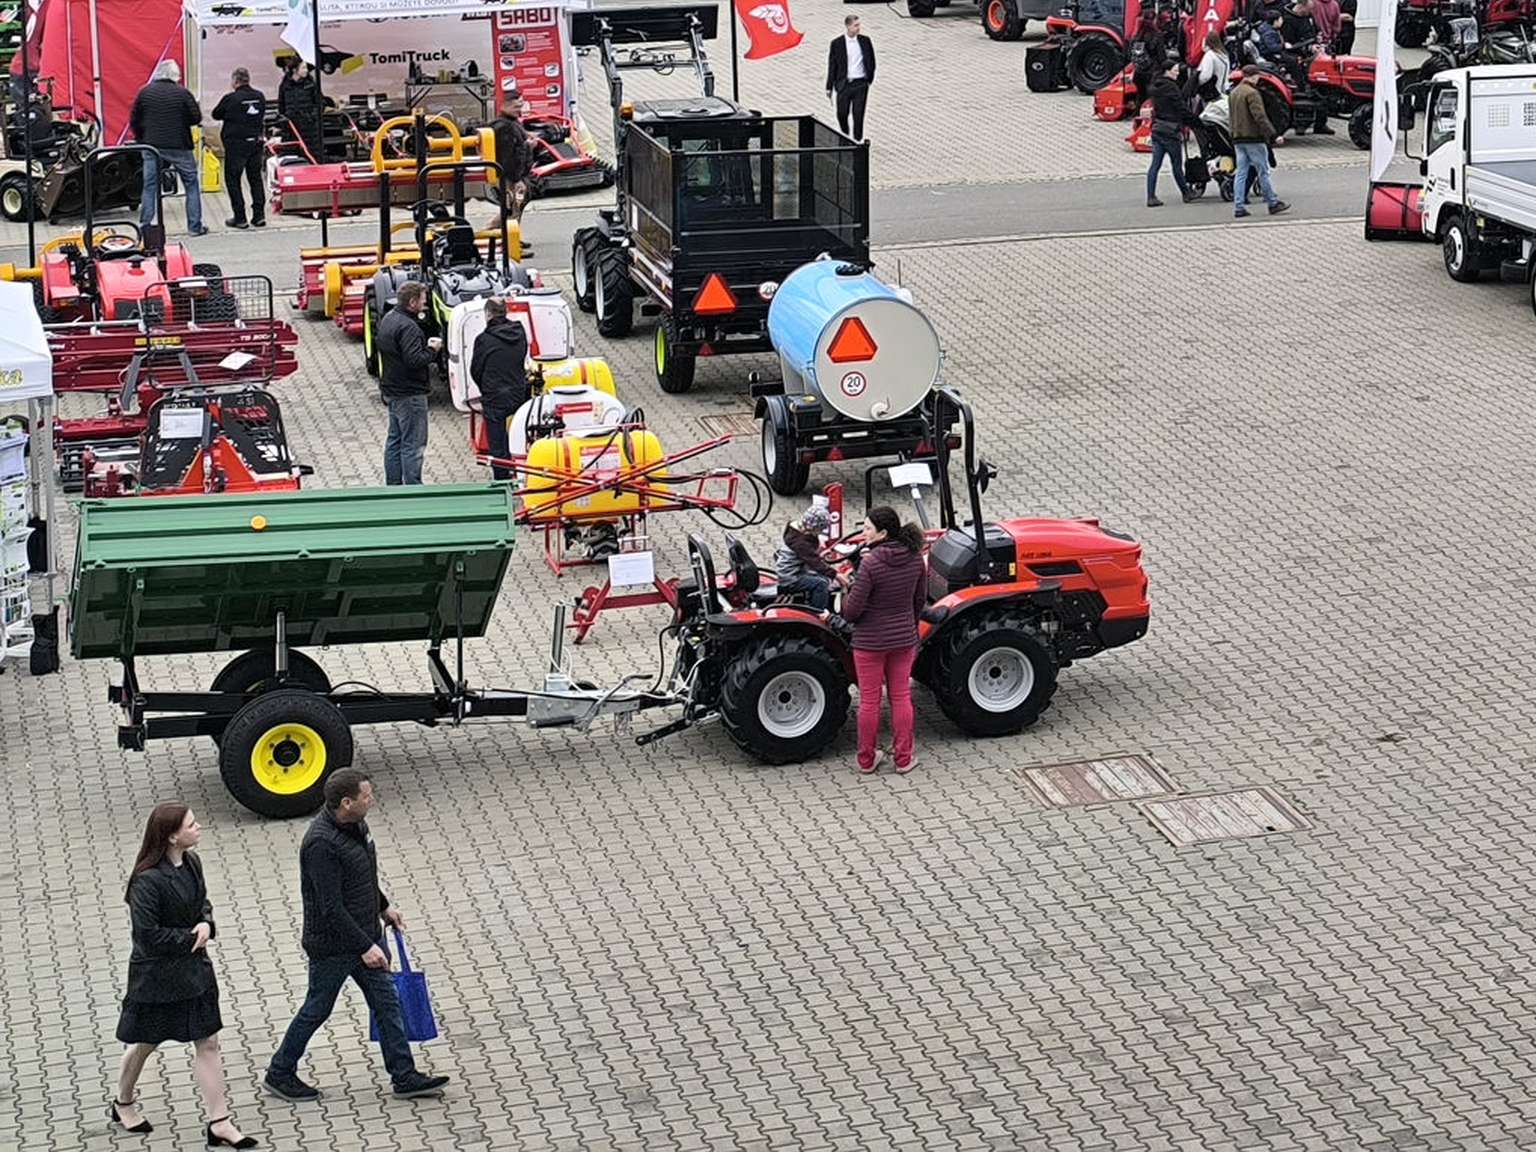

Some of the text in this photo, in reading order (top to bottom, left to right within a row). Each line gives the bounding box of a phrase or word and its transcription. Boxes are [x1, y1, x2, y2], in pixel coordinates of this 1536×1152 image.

[500, 6, 551, 26] SABO
[369, 48, 450, 66] TomiTruck
[847, 375, 861, 388] 20
